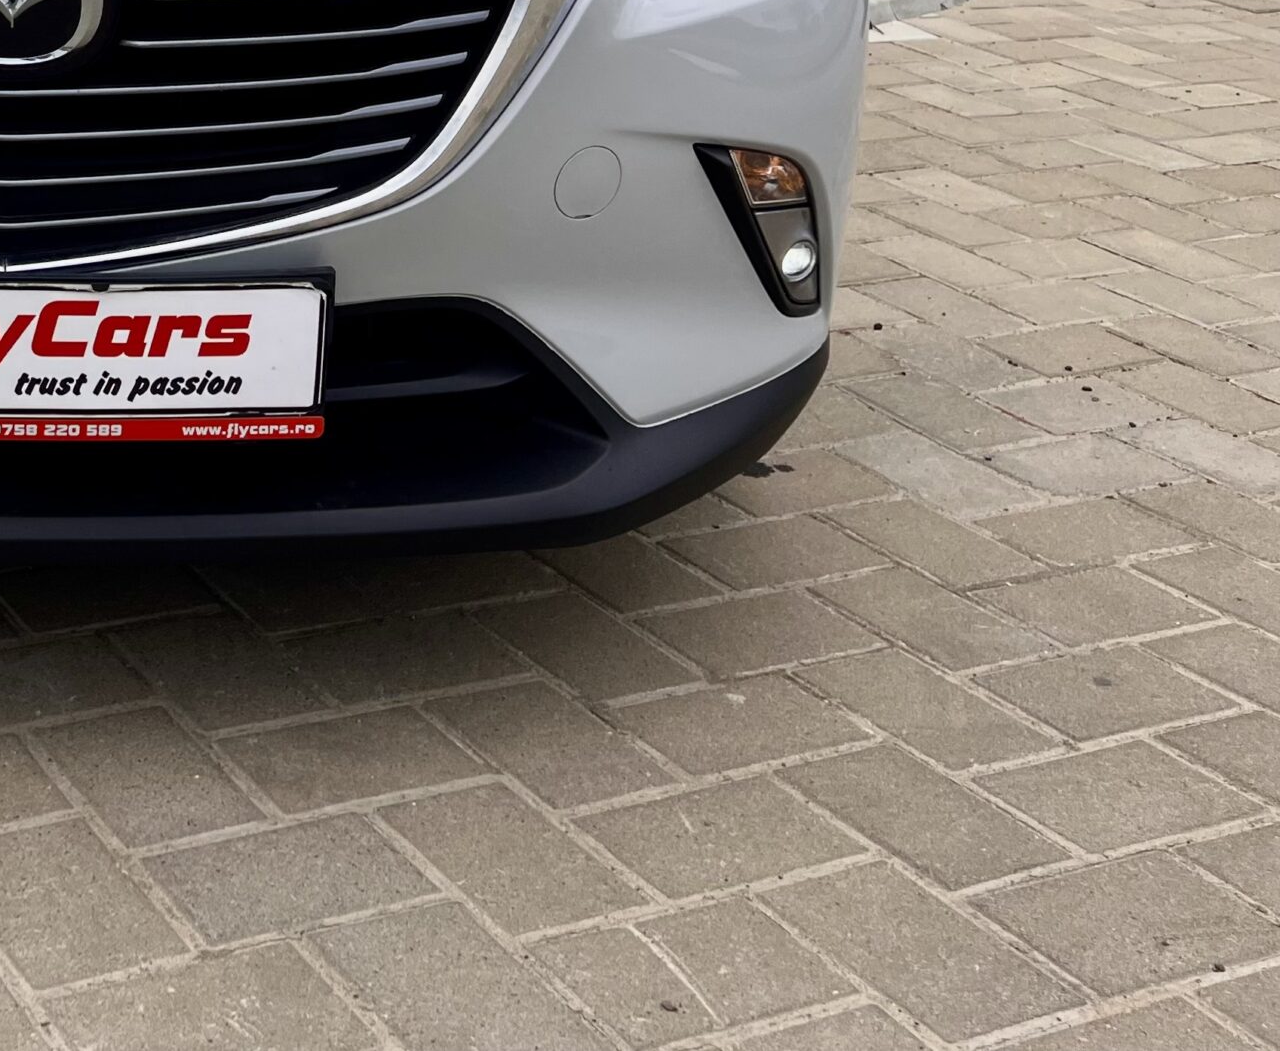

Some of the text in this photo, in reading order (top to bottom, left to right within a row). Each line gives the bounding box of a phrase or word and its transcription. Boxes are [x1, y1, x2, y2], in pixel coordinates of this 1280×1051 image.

[14, 370, 243, 402] trust in passion
[43, 424, 81, 437] 220
[86, 424, 122, 436] 589
[181, 423, 315, 439] www.flycars.ro
